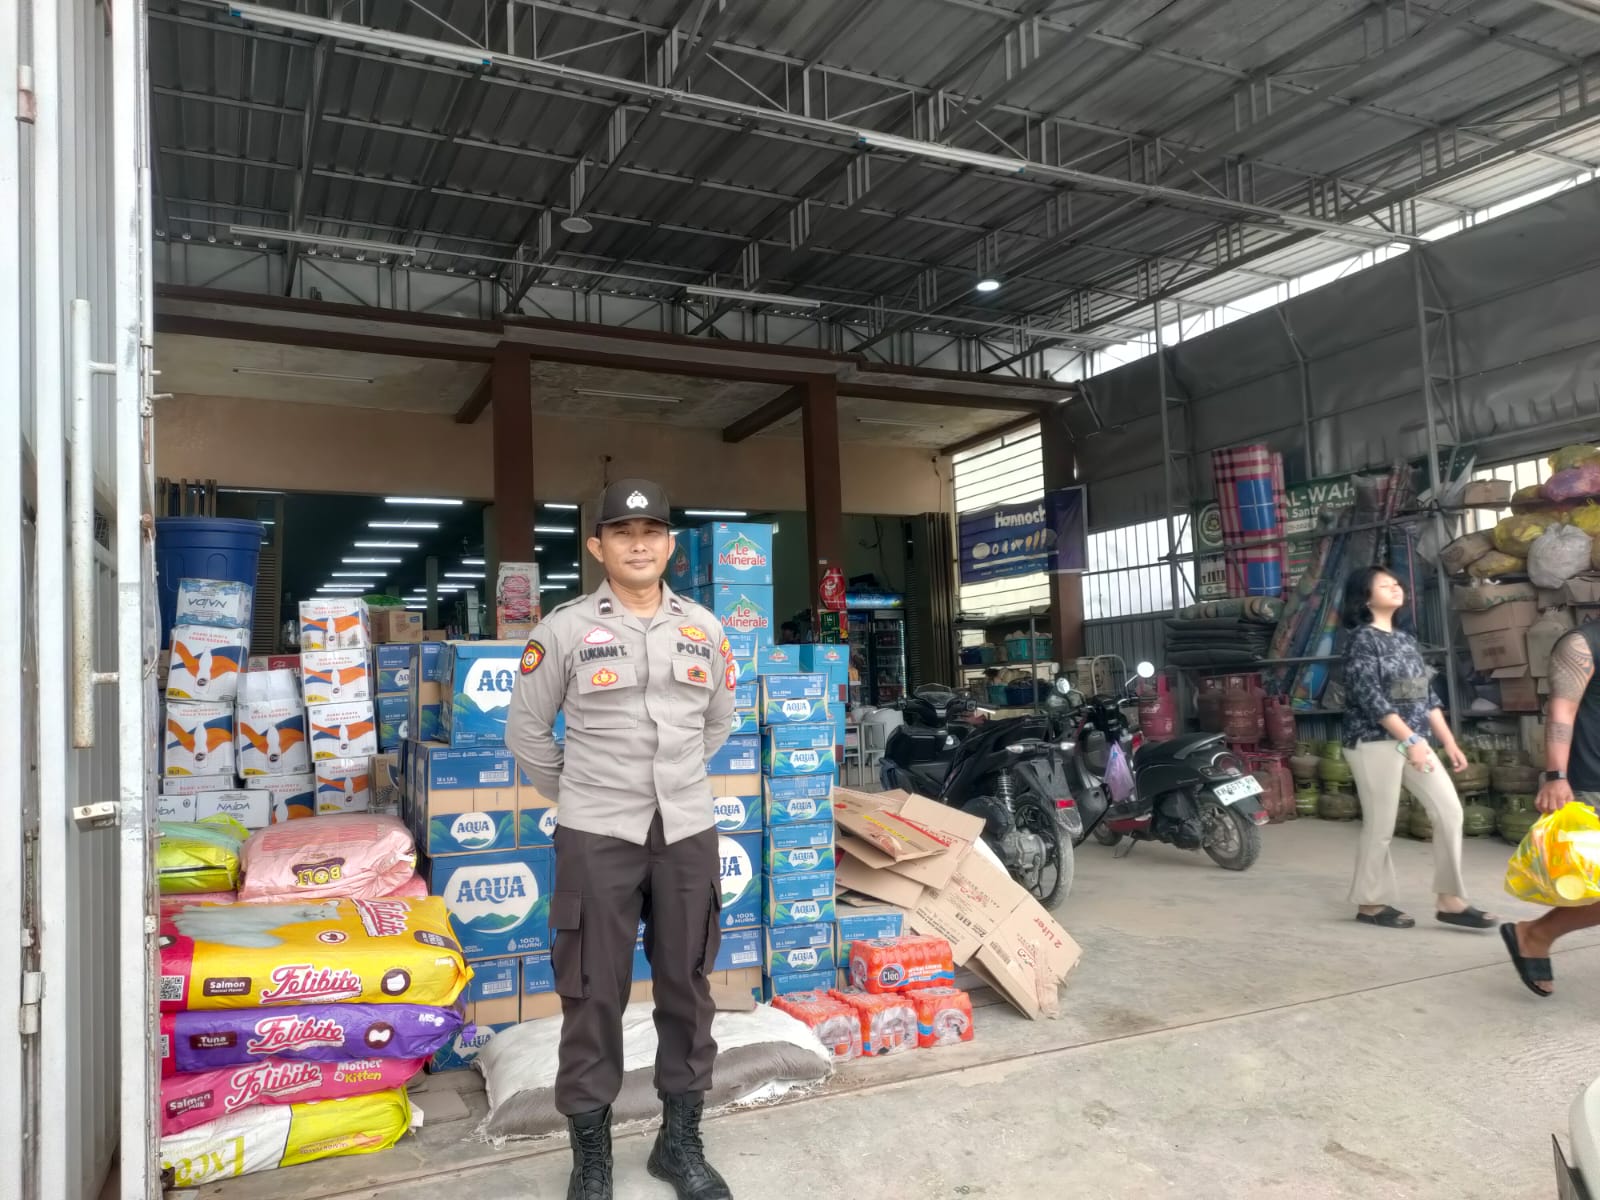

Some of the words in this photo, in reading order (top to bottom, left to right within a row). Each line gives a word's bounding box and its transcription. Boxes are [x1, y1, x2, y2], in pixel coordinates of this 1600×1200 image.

[735, 543, 749, 556] Le
[719, 553, 767, 567] Minerale
[737, 606, 751, 618] Le
[721, 616, 769, 629] Minerale
[579, 646, 616, 662] LUKMAN
[477, 669, 517, 693] AQ
[786, 702, 807, 713] AQUA
[793, 752, 815, 763] AQUA
[713, 804, 740, 817] AQUA
[791, 801, 812, 812] AQUA
[457, 820, 490, 834] AQUA
[792, 852, 814, 863] AQUA
[456, 875, 526, 904] AQUA
[794, 904, 816, 915] AQUA
[517, 941, 543, 949] MURNI
[519, 937, 541, 945] 100%
[791, 952, 814, 962] AQUA
[882, 971, 899, 981] Cleo
[210, 981, 246, 989] Salmon
[262, 965, 361, 1003] Felibite
[200, 1036, 226, 1044] Tuna
[249, 1016, 344, 1053] Felibite
[337, 1059, 383, 1072] Mother
[345, 1070, 382, 1083] Kitten
[226, 1063, 321, 1112] Felibite
[169, 1093, 211, 1111] Salmon
[158, 1136, 245, 1187] Exce
